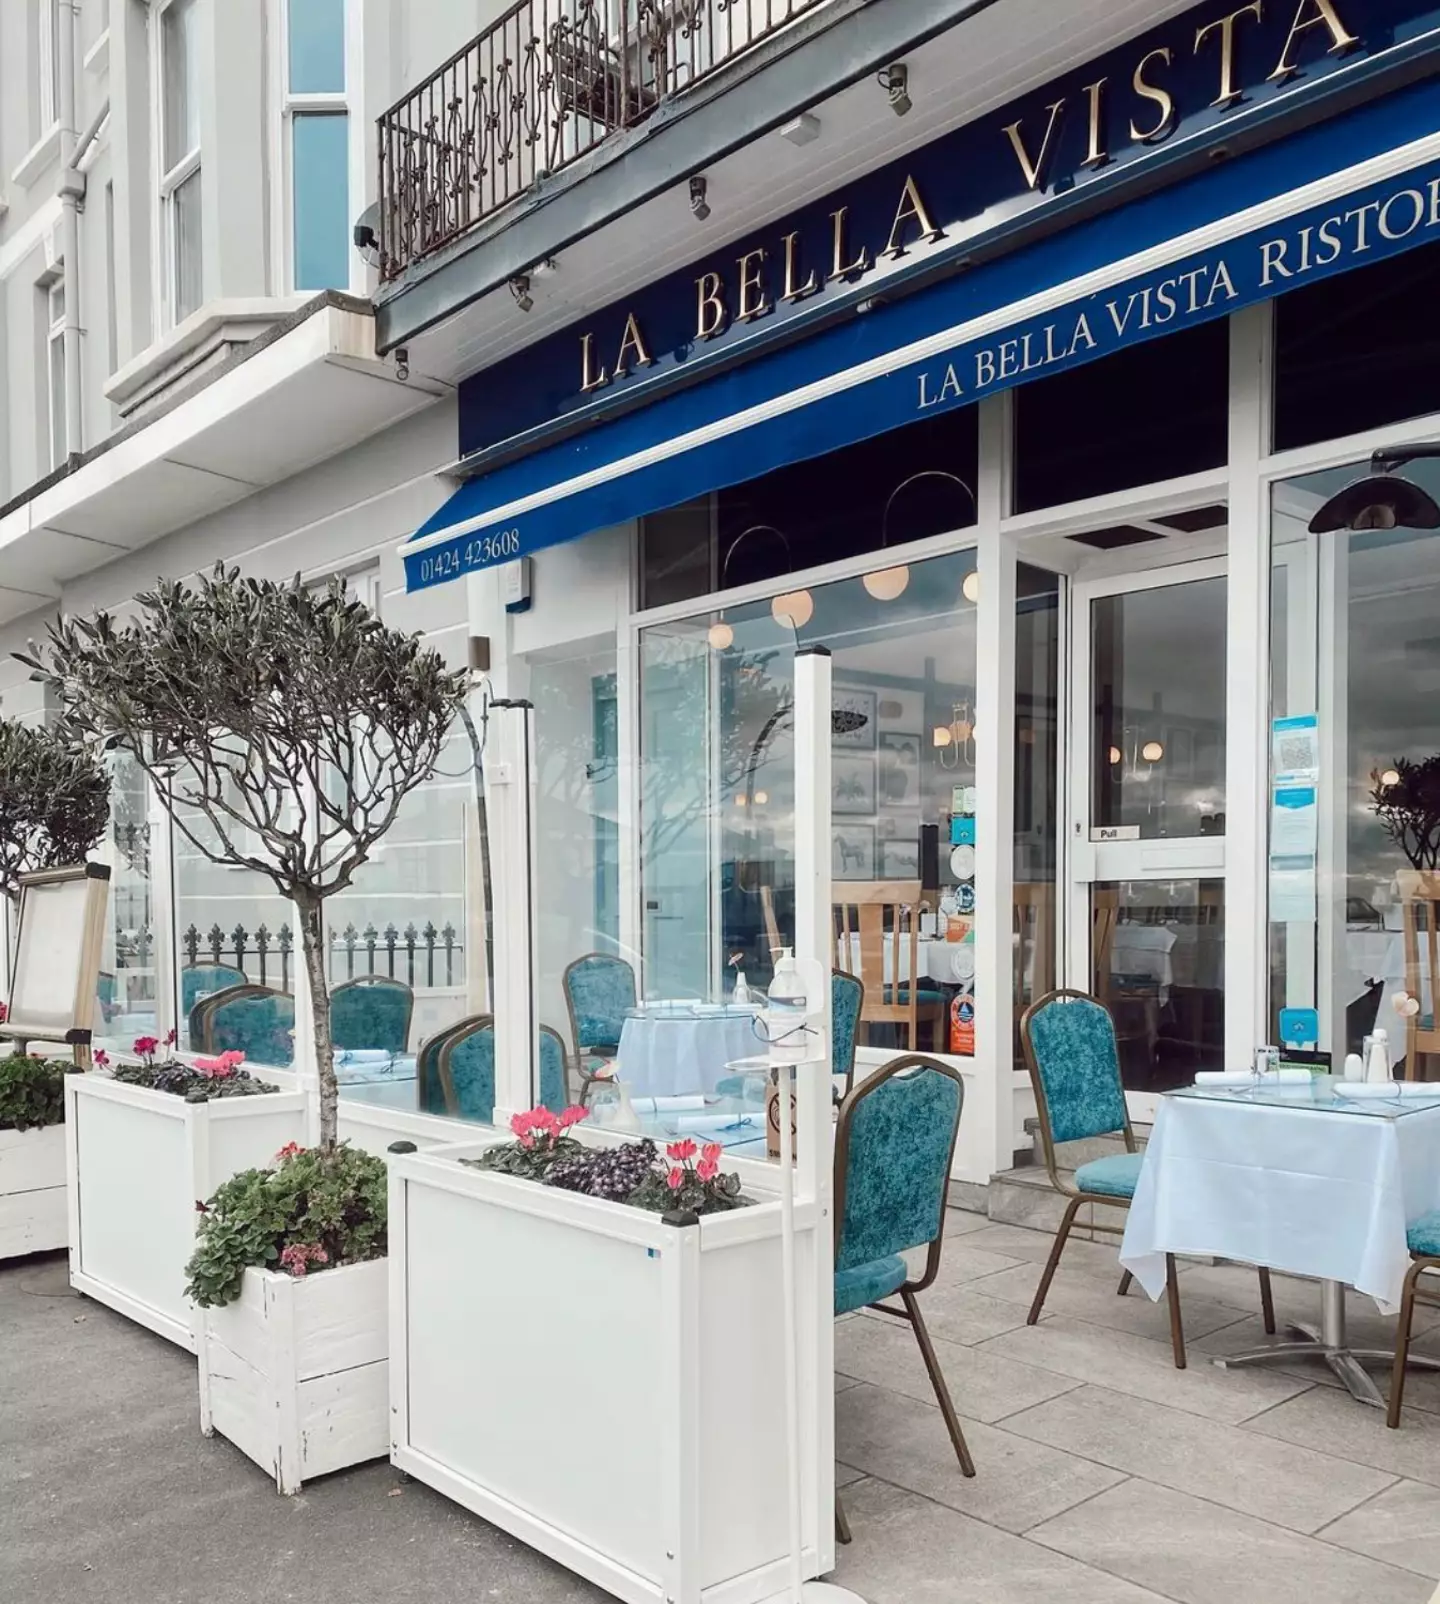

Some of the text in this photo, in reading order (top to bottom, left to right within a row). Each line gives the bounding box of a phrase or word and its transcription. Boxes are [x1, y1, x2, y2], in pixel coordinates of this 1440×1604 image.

[579, 0, 1360, 393] LA BELLA VISTA
[916, 363, 964, 410] LA
[974, 312, 1097, 389] BELLA
[1105, 260, 1239, 337] VISTA
[420, 528, 519, 582] 01424 423608
[1100, 829, 1118, 839] Pull
